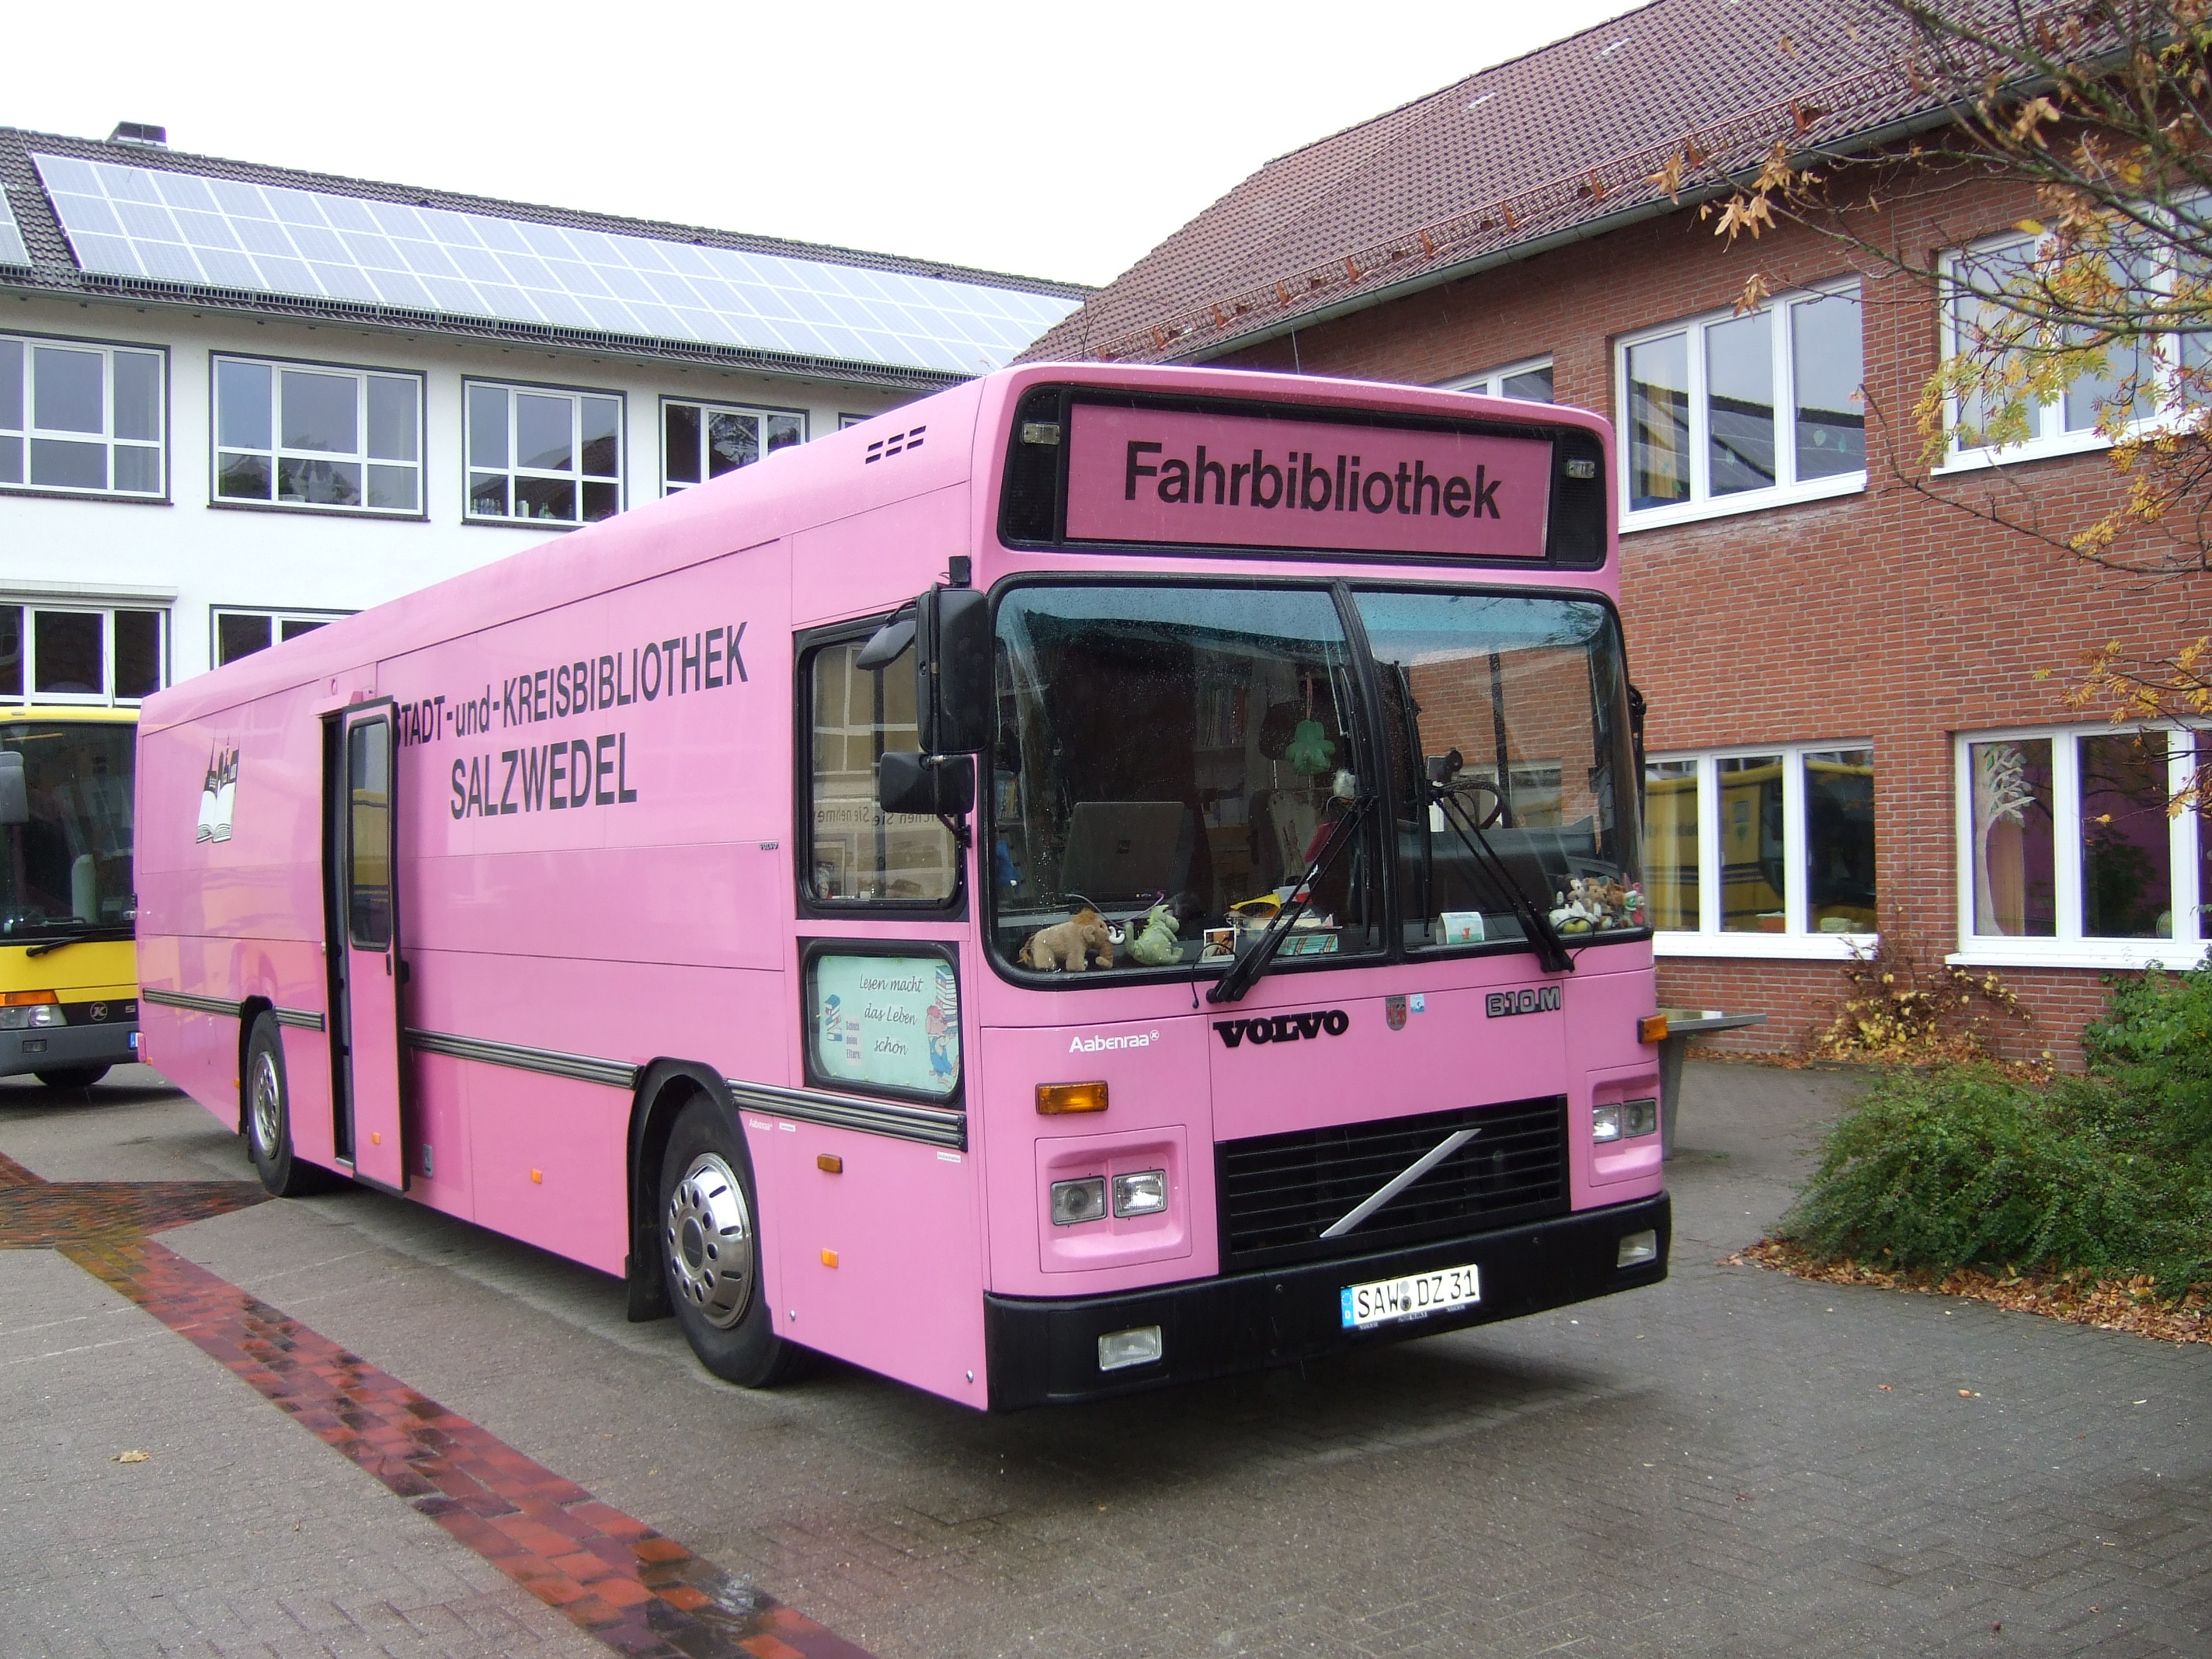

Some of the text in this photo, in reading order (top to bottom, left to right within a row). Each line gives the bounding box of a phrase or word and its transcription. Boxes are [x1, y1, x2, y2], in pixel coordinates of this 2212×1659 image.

[1125, 440, 1502, 520] Fahrbibliothek
[450, 732, 637, 820] SALZWEDEL
[860, 973, 923, 993] Lesen macht
[864, 1003, 917, 1025] das Leben
[1212, 1010, 1349, 1048] VOLVO
[875, 1036, 908, 1056] schön
[1069, 1031, 1150, 1053] Aabenraa
[1358, 1282, 1399, 1318] SAW
[1417, 1275, 1445, 1306] DZ
[1450, 1269, 1476, 1300] 31
